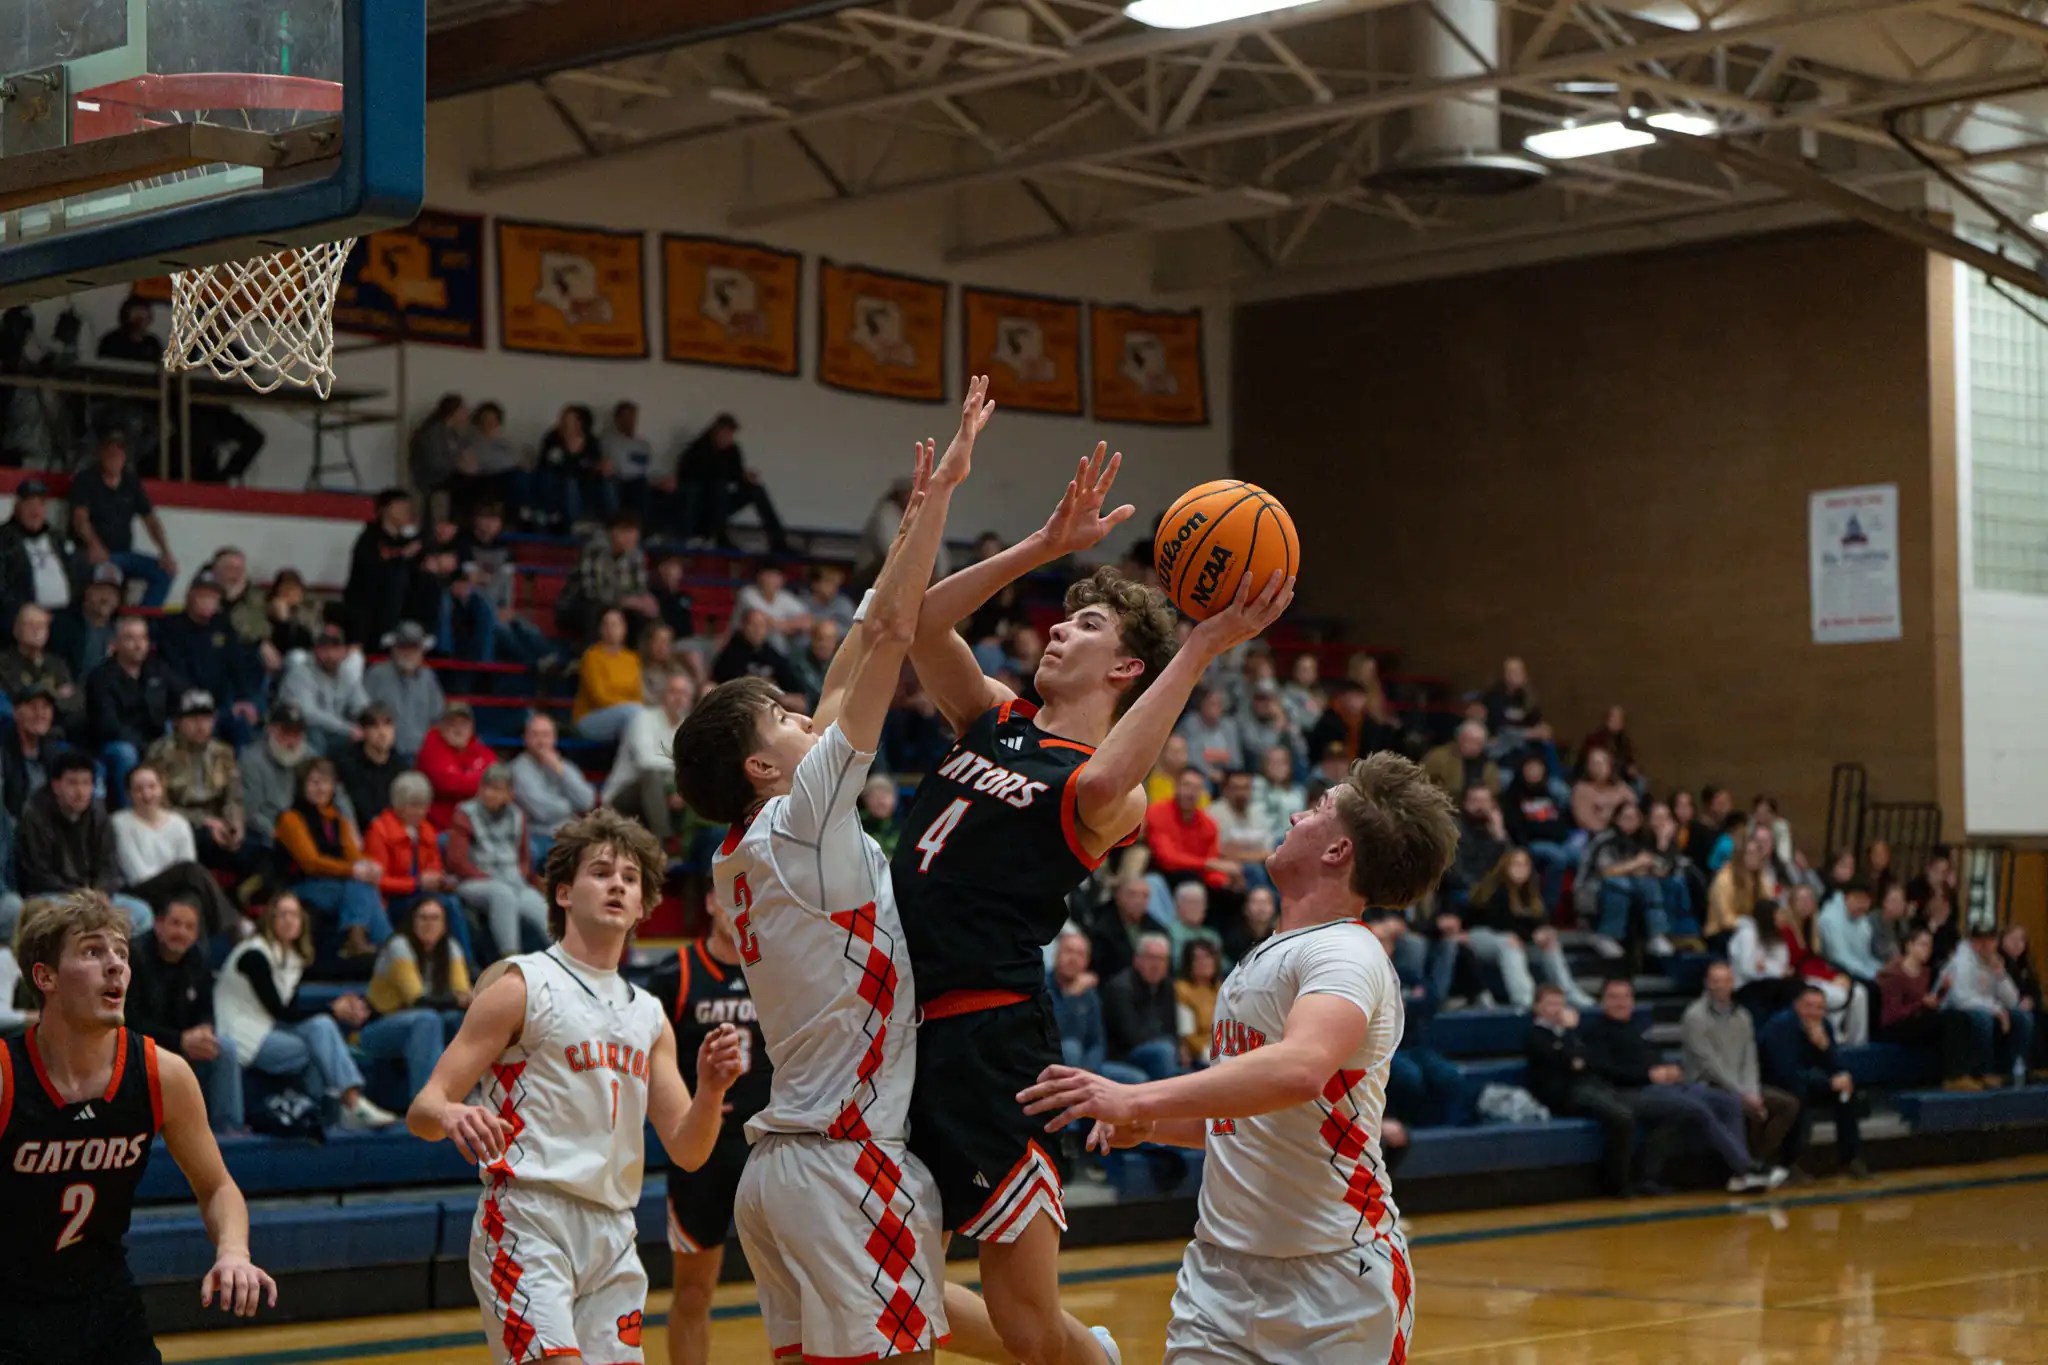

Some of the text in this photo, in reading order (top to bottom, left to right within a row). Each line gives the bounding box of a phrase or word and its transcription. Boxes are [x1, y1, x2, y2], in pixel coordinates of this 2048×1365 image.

[1160, 511, 1208, 593] Wilson
[1190, 545, 1233, 609] NCAA
[938, 744, 1050, 809] ATORS
[916, 797, 973, 874] 4
[734, 872, 762, 967] 2
[695, 998, 757, 1024] GATO
[565, 1041, 649, 1083] CLRIO
[13, 1132, 148, 1173] GATORS
[56, 1182, 97, 1251] 2
